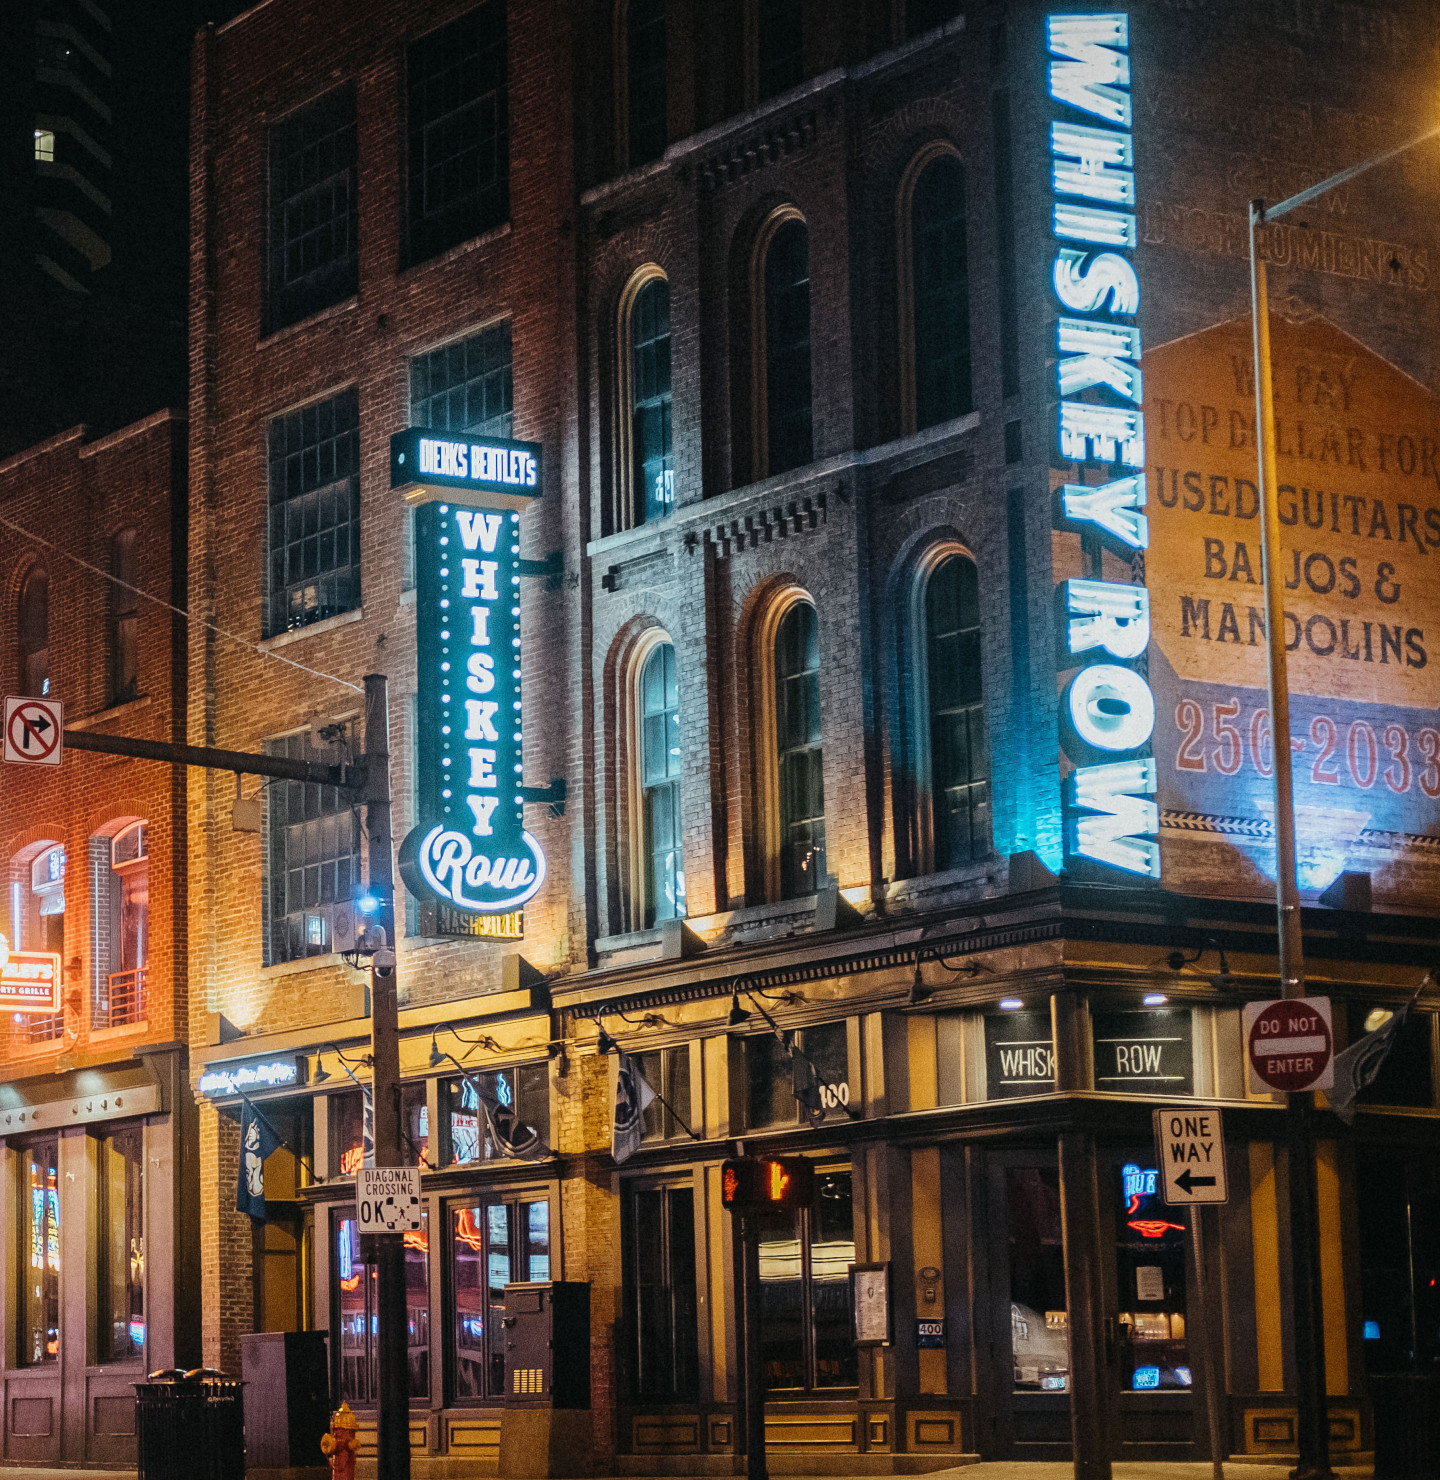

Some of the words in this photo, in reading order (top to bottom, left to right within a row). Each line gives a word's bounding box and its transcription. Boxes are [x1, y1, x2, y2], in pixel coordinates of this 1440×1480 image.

[1046, 12, 1149, 550] WHISKEY
[1295, 359, 1360, 413] PAY
[1154, 396, 1220, 446] TOP
[1377, 434, 1440, 485] FOR
[419, 437, 468, 479] DIERKS
[1156, 466, 1260, 521] USED
[1277, 483, 1440, 555] GUITARS
[1202, 536, 1360, 599] BAJOS
[1374, 561, 1401, 605] &
[455, 510, 504, 837] WHISKEY
[1067, 577, 1161, 879] ROW
[432, 830, 537, 901] Row
[440, 904, 524, 937] NASHVILLE
[18, 987, 50, 996] GRILLE
[1259, 1018, 1281, 1034] DO
[1287, 1016, 1319, 1033] NOT
[1116, 1045, 1162, 1074] ROW
[1266, 1056, 1315, 1075] ENTER
[1170, 1116, 1212, 1138] ONE
[1170, 1142, 1215, 1164] WAY
[365, 1170, 414, 1183] DIAGONAL
[365, 1183, 414, 1196] CROSSING
[361, 1200, 385, 1224] OK
[918, 1323, 942, 1336] 400
